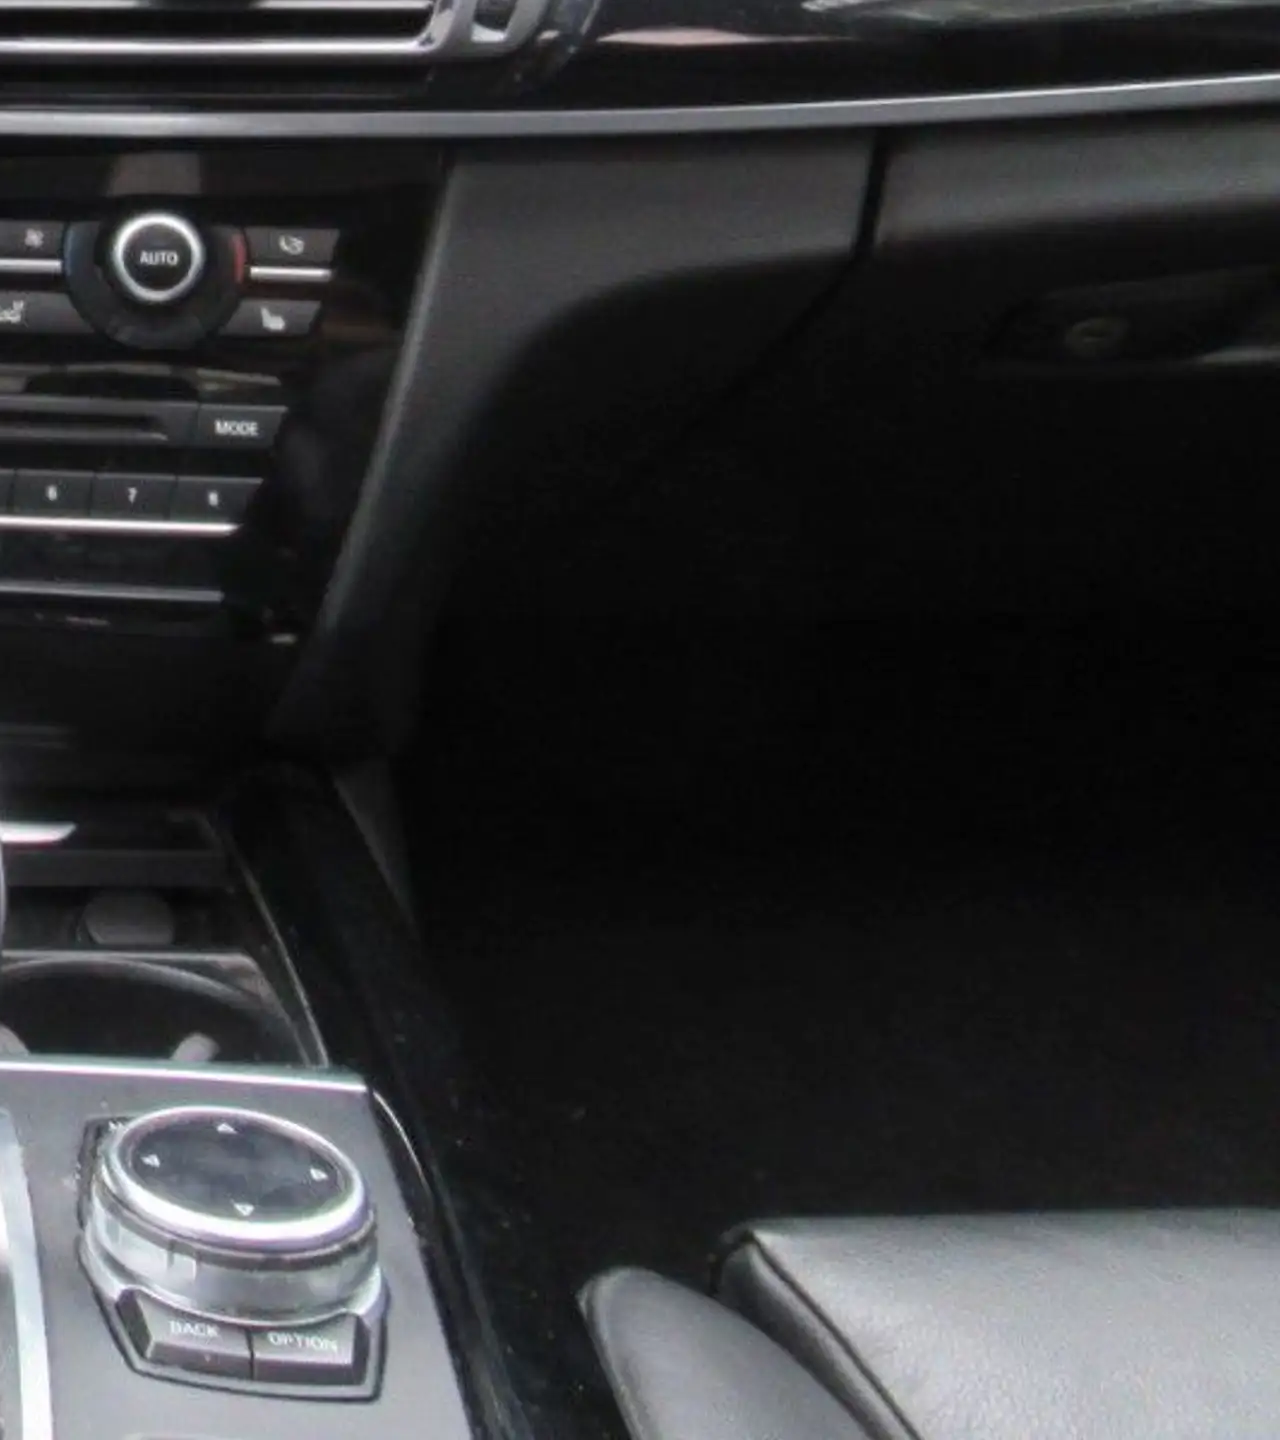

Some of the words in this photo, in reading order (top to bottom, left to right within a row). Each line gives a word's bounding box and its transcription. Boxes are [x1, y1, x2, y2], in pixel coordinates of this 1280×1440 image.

[140, 251, 179, 266] AUTO
[214, 419, 259, 437] MODE
[128, 486, 138, 503] 7
[266, 1331, 339, 1353] OPTION
